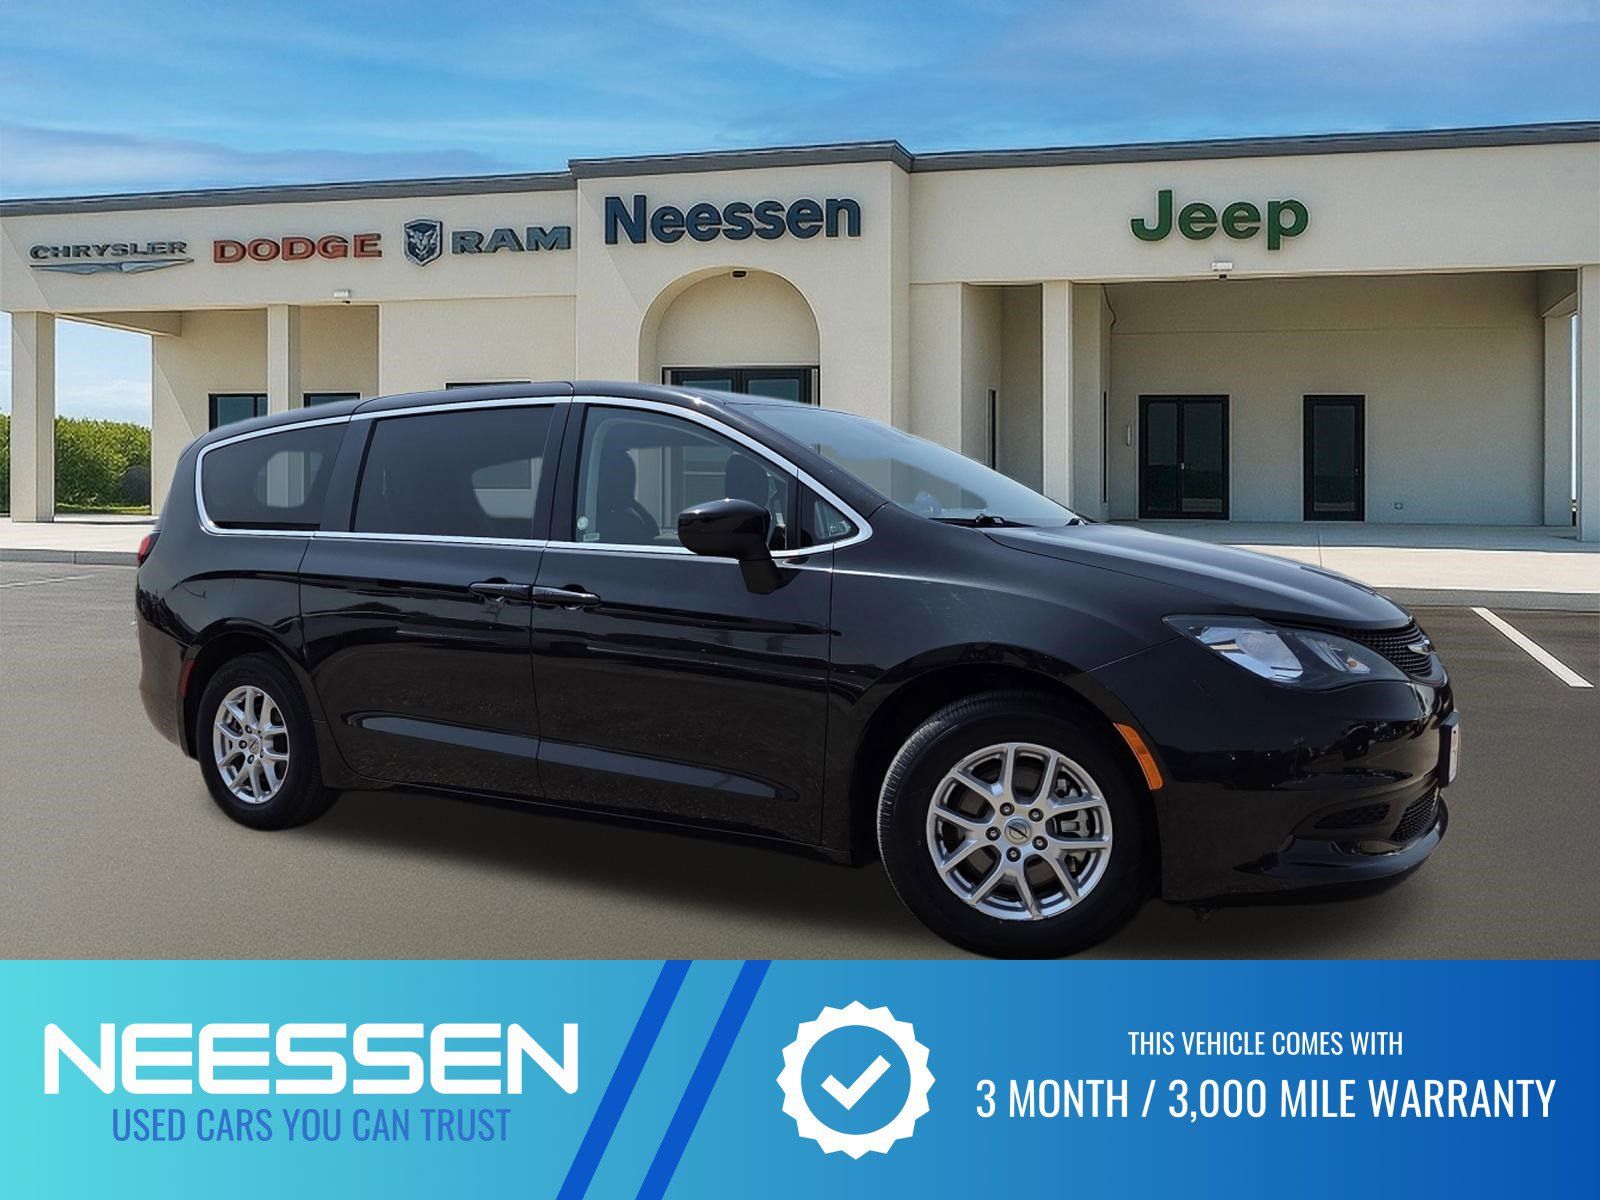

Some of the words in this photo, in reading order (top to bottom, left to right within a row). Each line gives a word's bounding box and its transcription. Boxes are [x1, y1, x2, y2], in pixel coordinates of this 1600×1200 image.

[604, 195, 861, 245] Neessen
[1130, 189, 1309, 251] Jeep
[30, 240, 188, 260] CHRYSLER
[213, 233, 383, 263] DODGE
[451, 226, 572, 255] RAM
